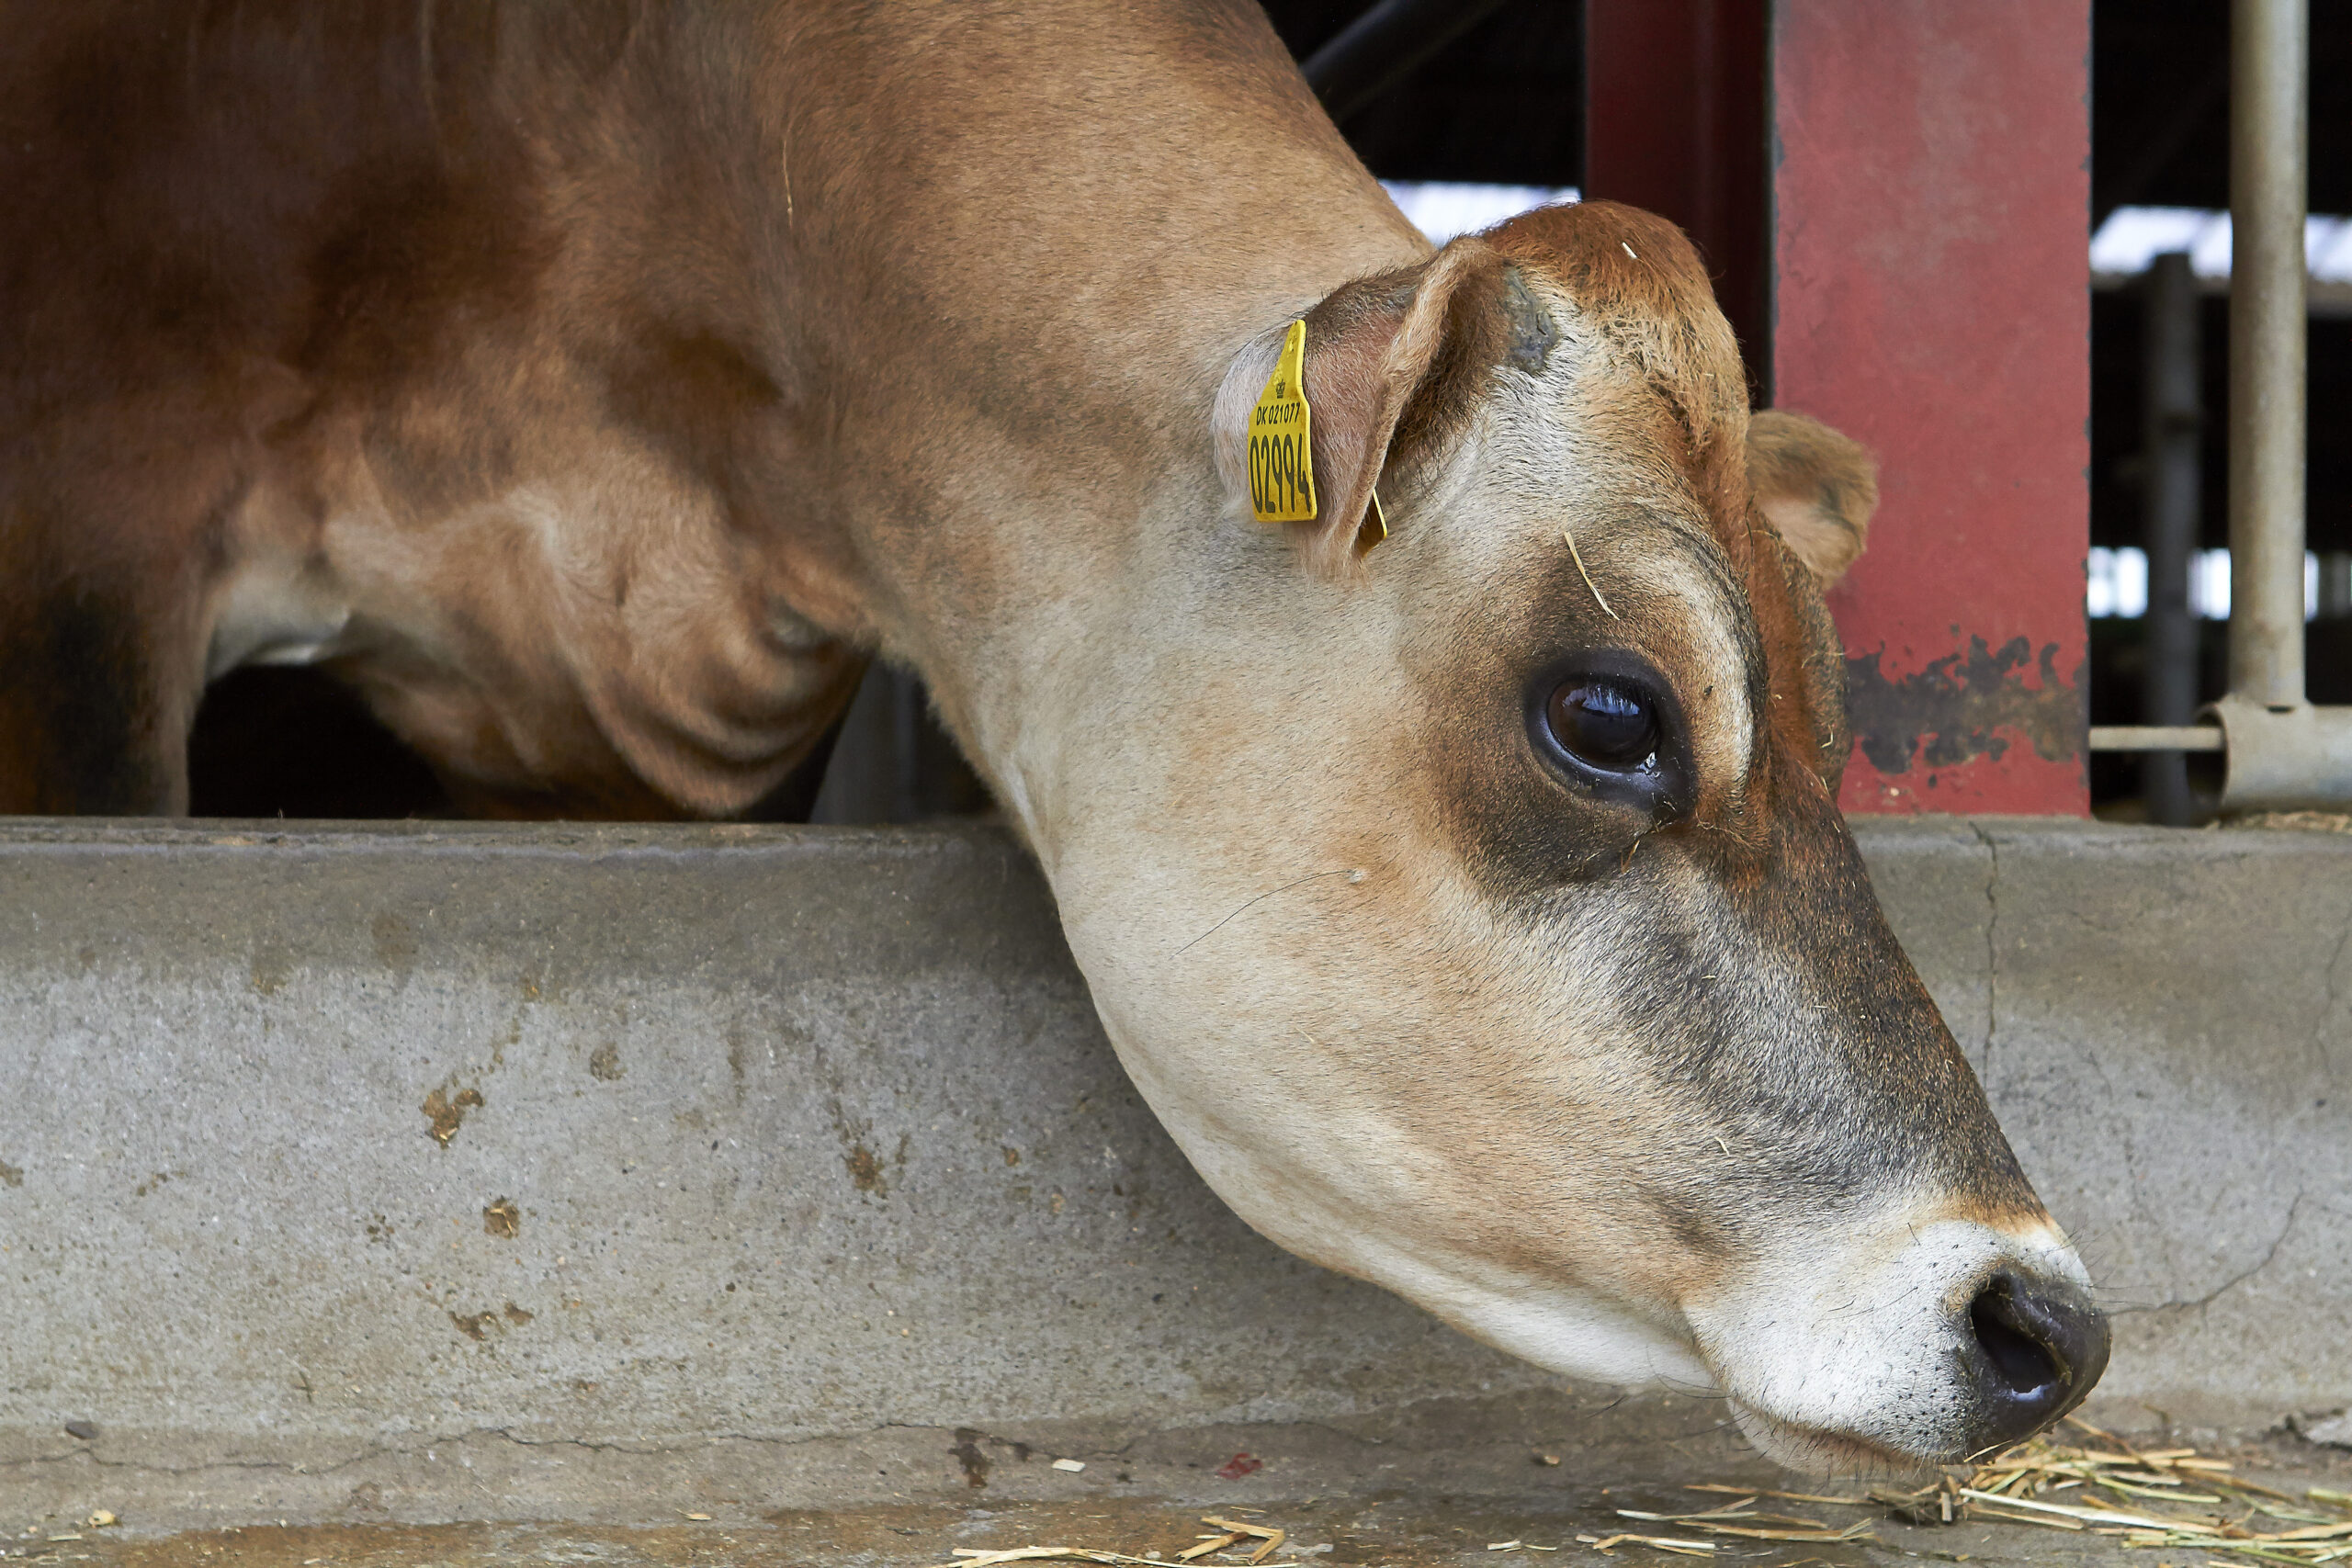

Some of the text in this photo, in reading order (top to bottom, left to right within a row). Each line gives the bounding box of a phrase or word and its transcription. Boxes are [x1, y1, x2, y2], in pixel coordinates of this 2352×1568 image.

[1256, 402, 1300, 425] DK 021077
[1250, 433, 1311, 513] 02994
